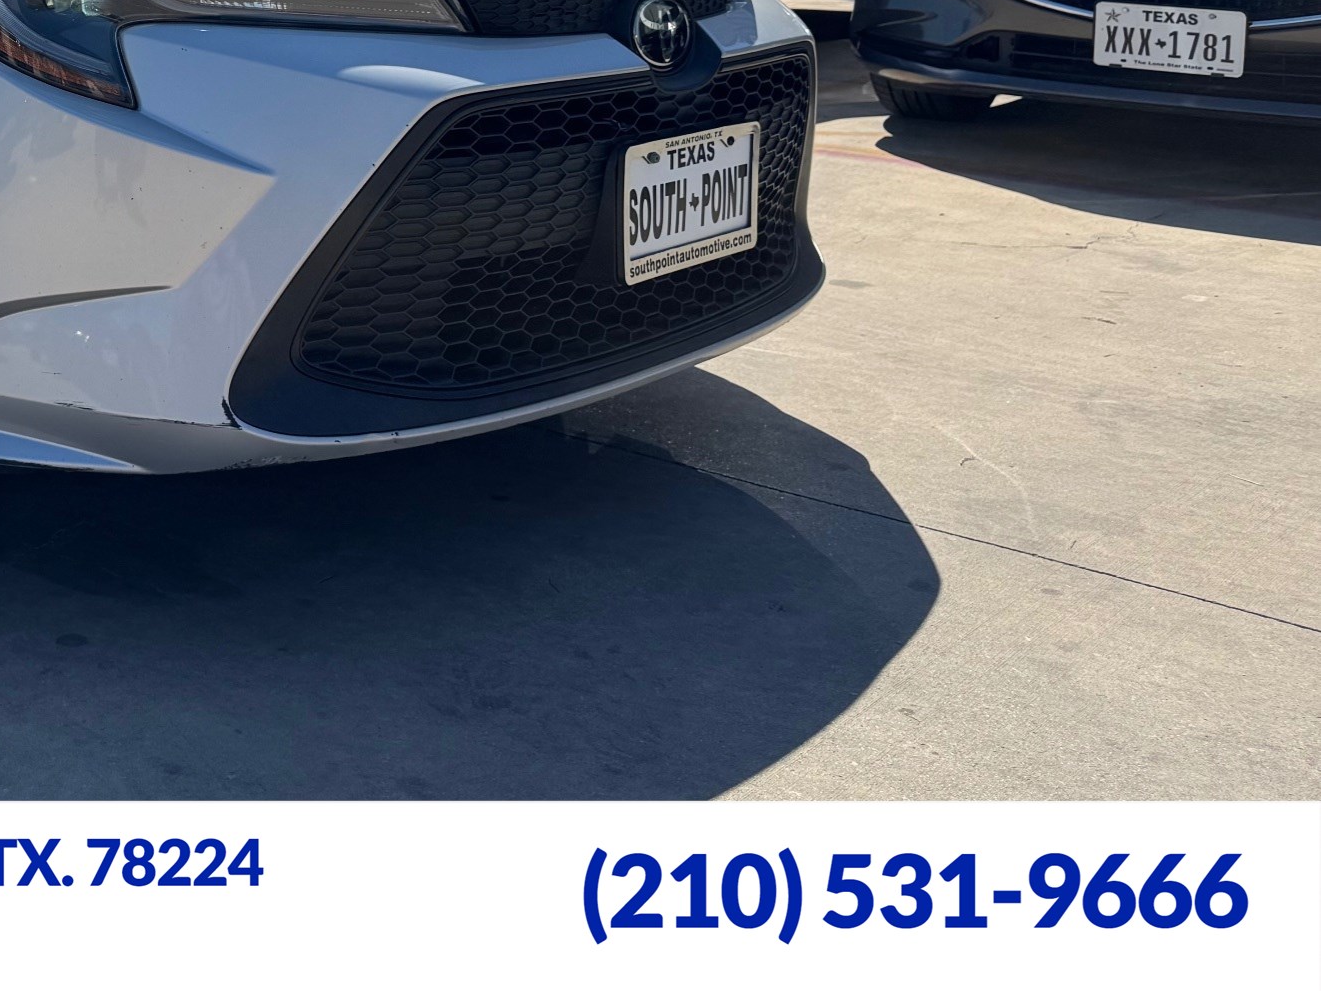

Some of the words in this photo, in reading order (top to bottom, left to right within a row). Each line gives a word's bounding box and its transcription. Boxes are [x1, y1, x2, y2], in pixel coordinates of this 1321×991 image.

[1142, 9, 1199, 26] TEXAS
[1182, 63, 1203, 71] State
[665, 139, 680, 149] SAN
[714, 130, 724, 138] TX
[666, 140, 716, 171] TEXAS
[629, 178, 688, 246] SOUTH
[700, 163, 748, 227] POINT
[629, 232, 753, 279] southpointautomotive.com
